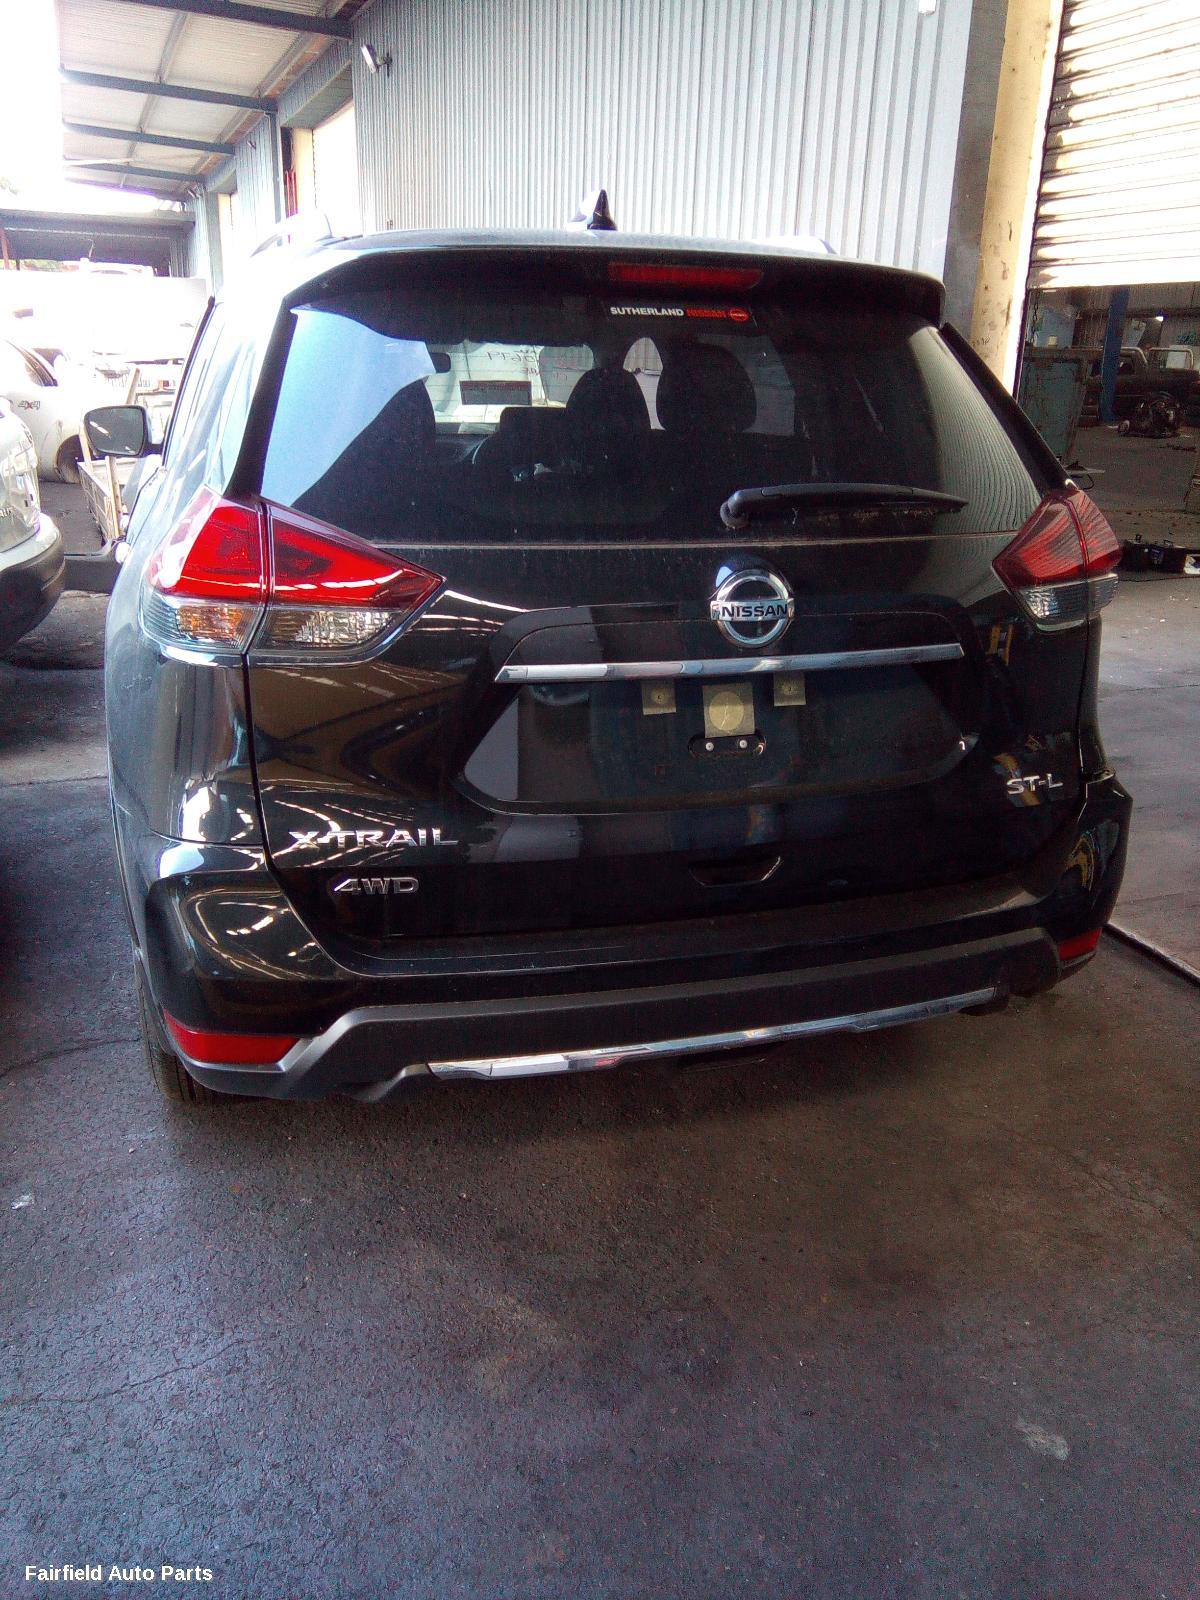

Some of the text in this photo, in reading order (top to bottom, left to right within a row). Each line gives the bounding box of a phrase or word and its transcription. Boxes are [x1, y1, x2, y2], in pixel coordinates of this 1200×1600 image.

[610, 306, 684, 317] SUTHERLAND
[721, 604, 788, 618] NISSAN
[1006, 773, 1064, 795] ST-L
[289, 828, 459, 849] X-TRAIL
[333, 876, 420, 896] 4WD
